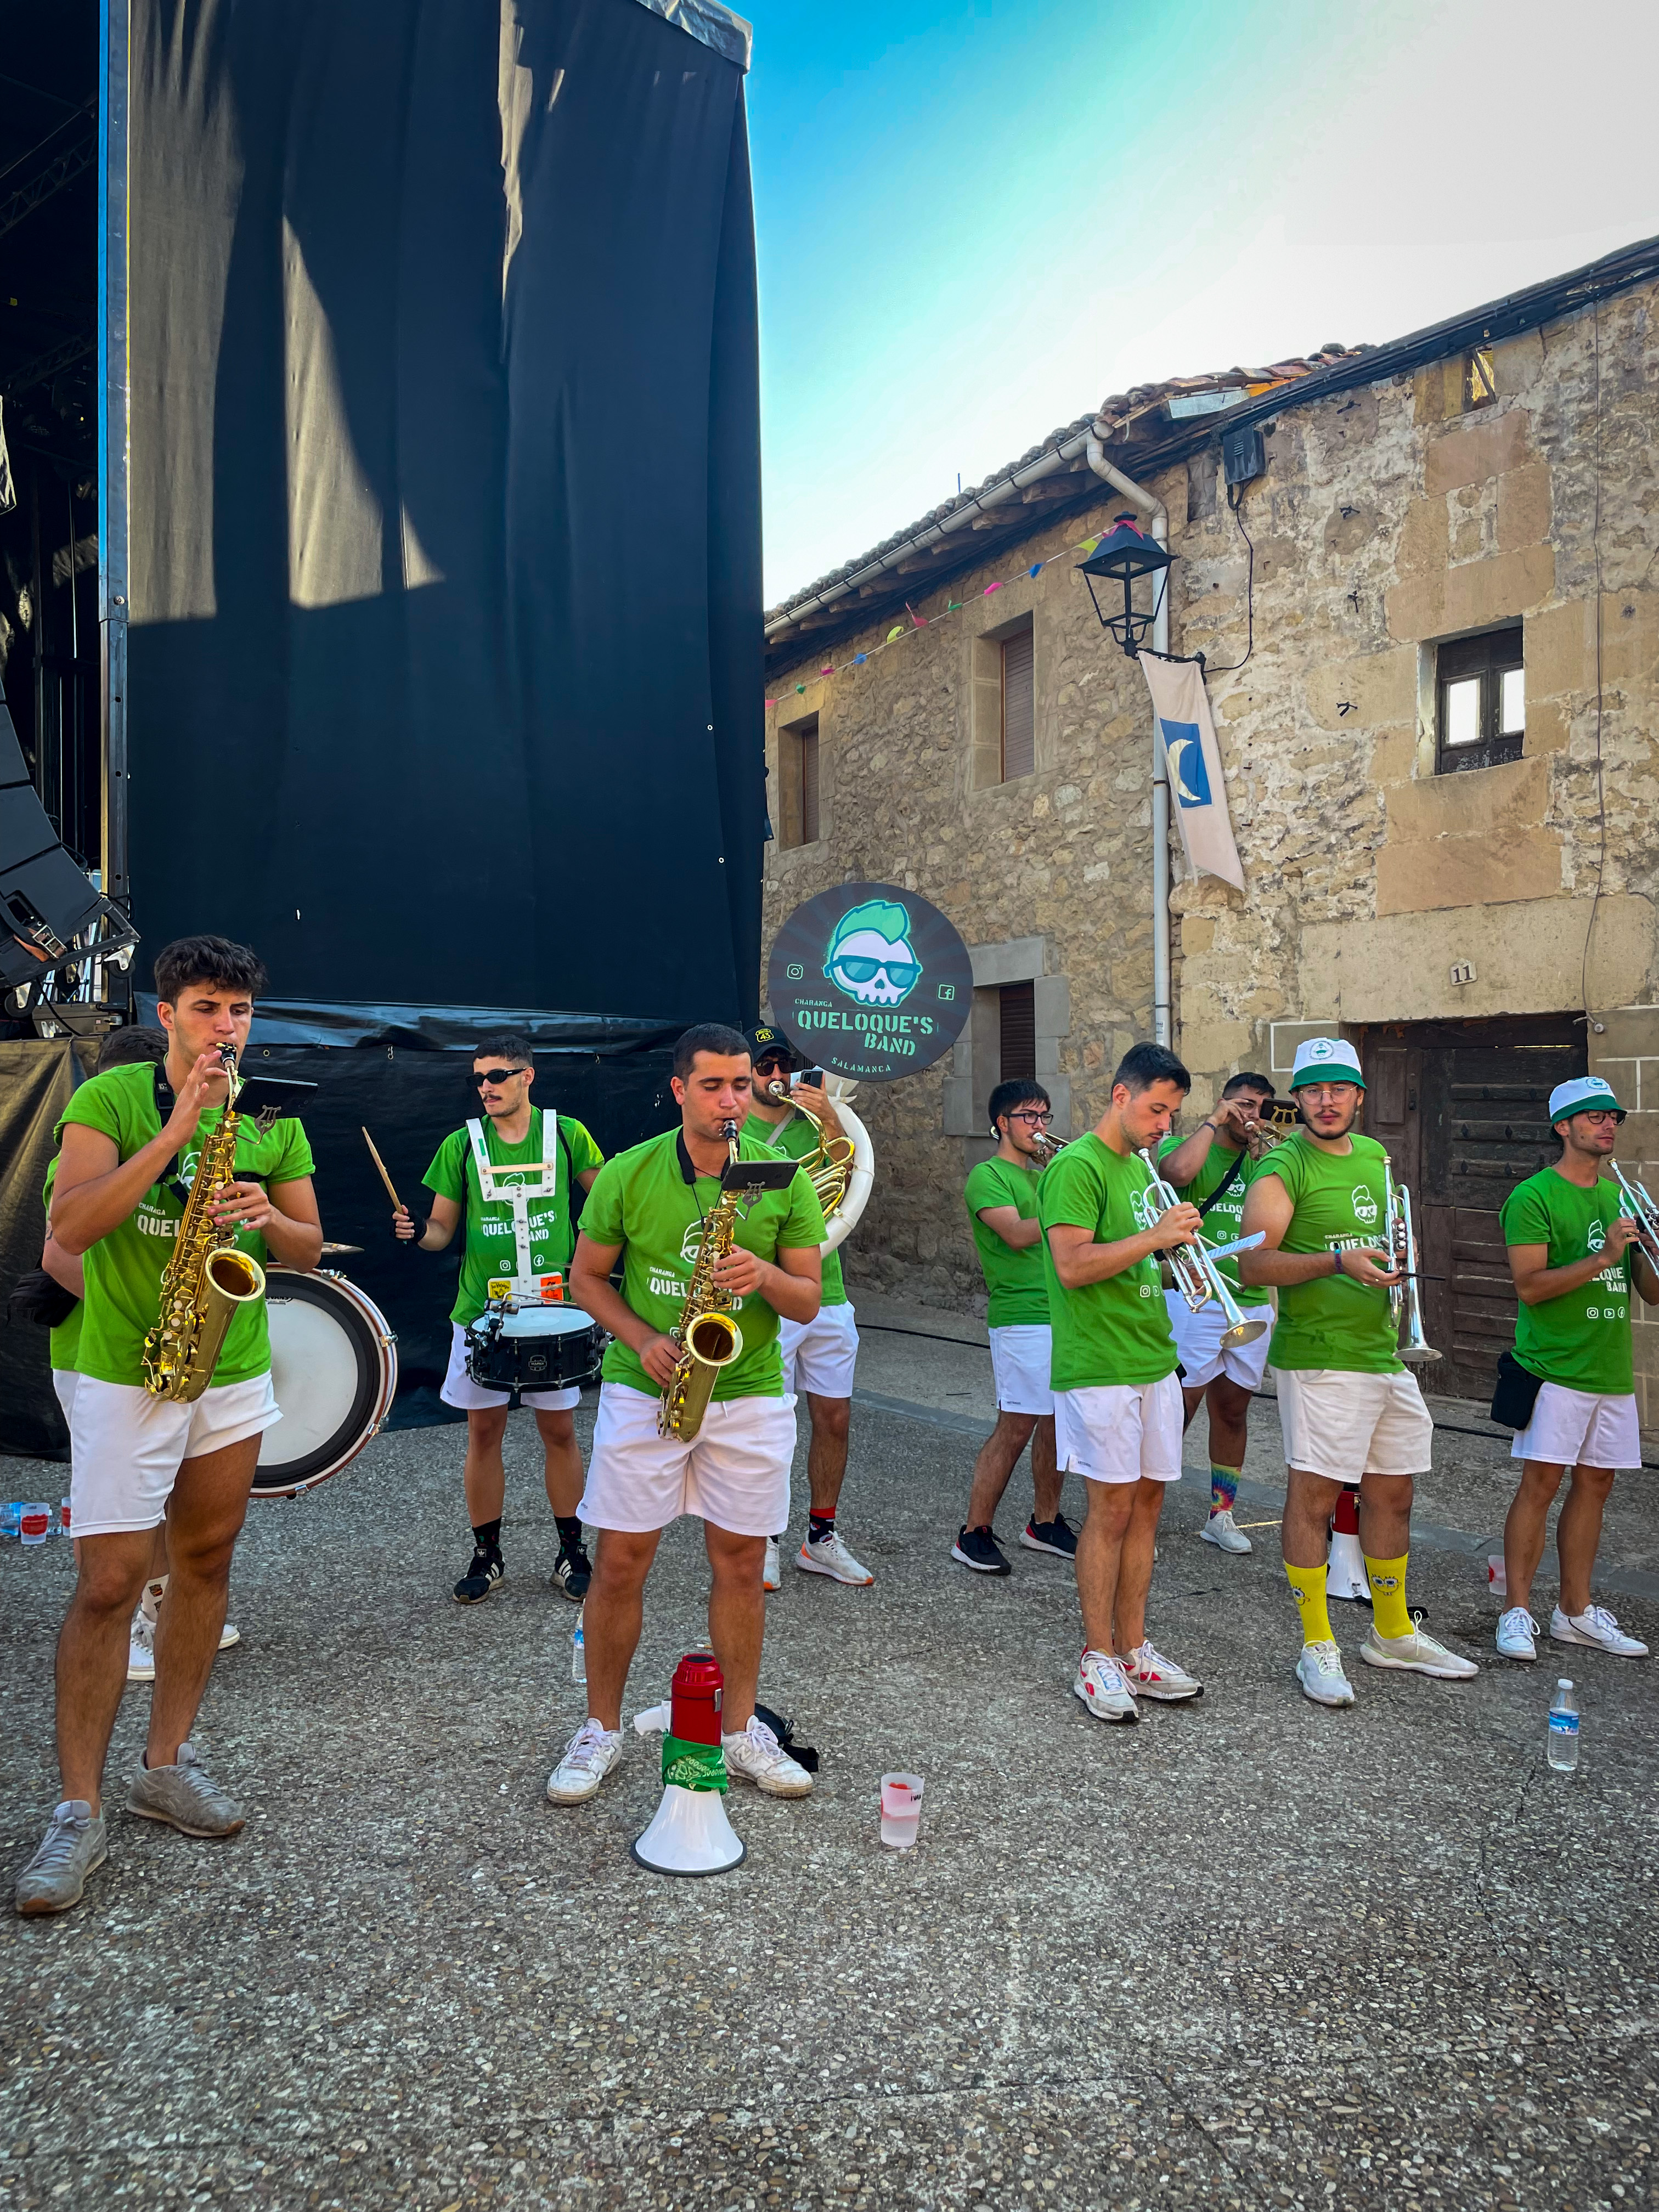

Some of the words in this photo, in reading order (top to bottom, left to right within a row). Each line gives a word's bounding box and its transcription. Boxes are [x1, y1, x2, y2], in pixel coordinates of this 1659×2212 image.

[1453, 966, 1472, 983] 11
[794, 998, 832, 1008] CHARANGA
[798, 1010, 933, 1035] QUELOQUE'S
[864, 1032, 916, 1056] BAND
[832, 1057, 891, 1073] SALAMANCA
[138, 1202, 166, 1216] CHARAGA
[483, 1210, 555, 1237] QUELUE'S
[650, 1266, 675, 1278] CHARANGA
[1606, 1281, 1627, 1293] BAND
